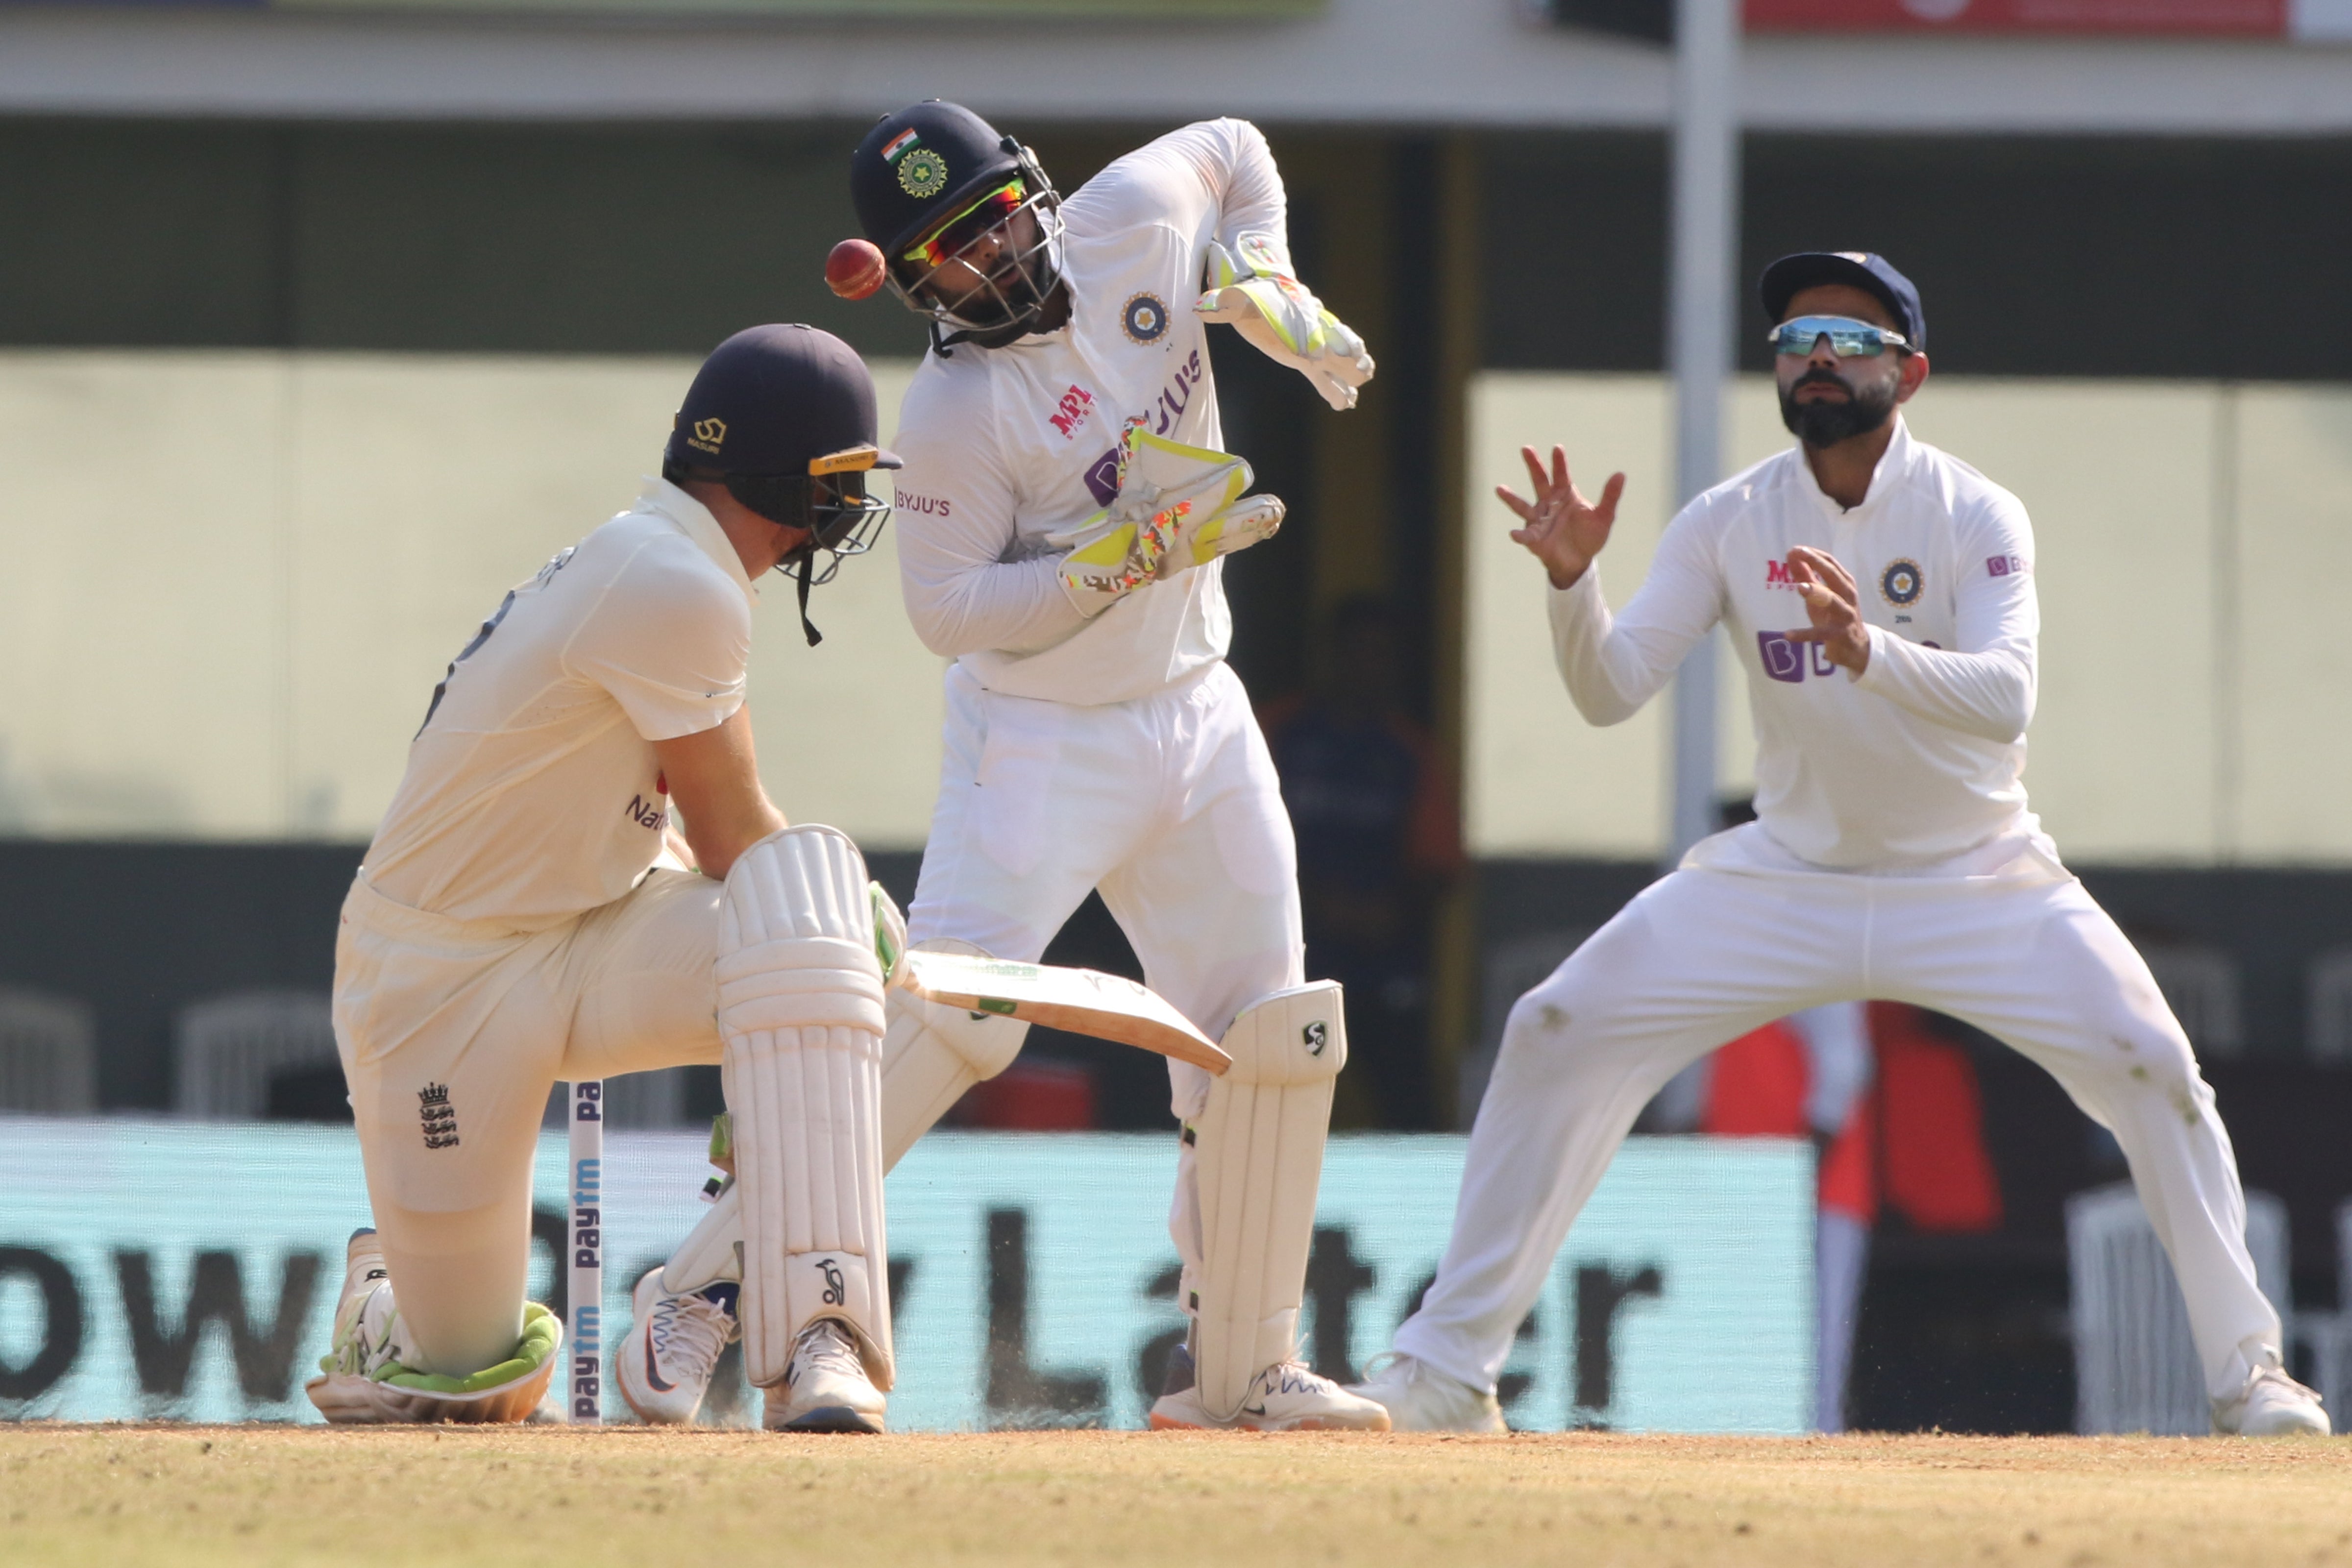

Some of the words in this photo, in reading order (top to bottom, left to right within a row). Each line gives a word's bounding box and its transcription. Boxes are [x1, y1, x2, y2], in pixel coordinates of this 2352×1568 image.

[898, 490, 950, 516] BYJU'S
[572, 1159, 601, 1268] paytm
[571, 1306, 600, 1419] paytm
